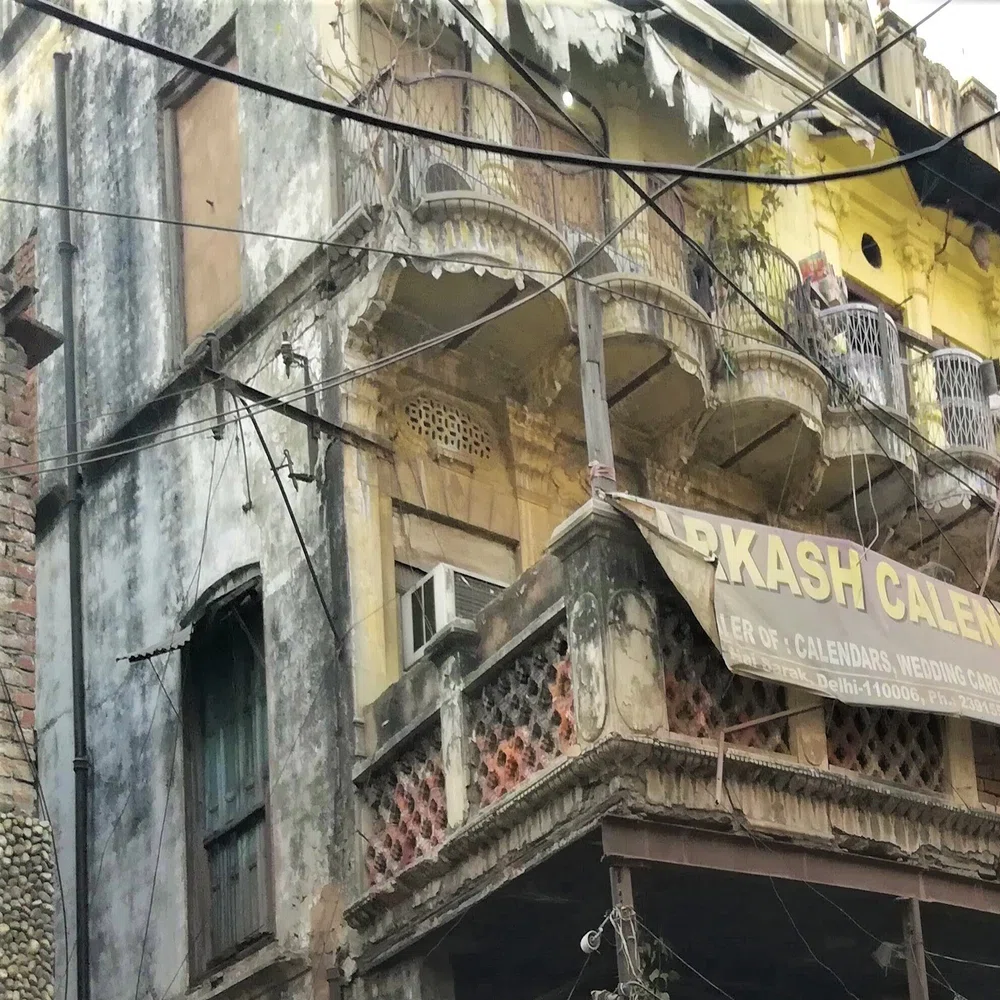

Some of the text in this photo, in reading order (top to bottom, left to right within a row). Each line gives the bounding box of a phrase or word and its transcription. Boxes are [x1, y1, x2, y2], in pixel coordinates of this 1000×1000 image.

[656, 510, 866, 613] RKASH
[758, 625, 778, 649] OF
[896, 653, 966, 687] WEDDING
